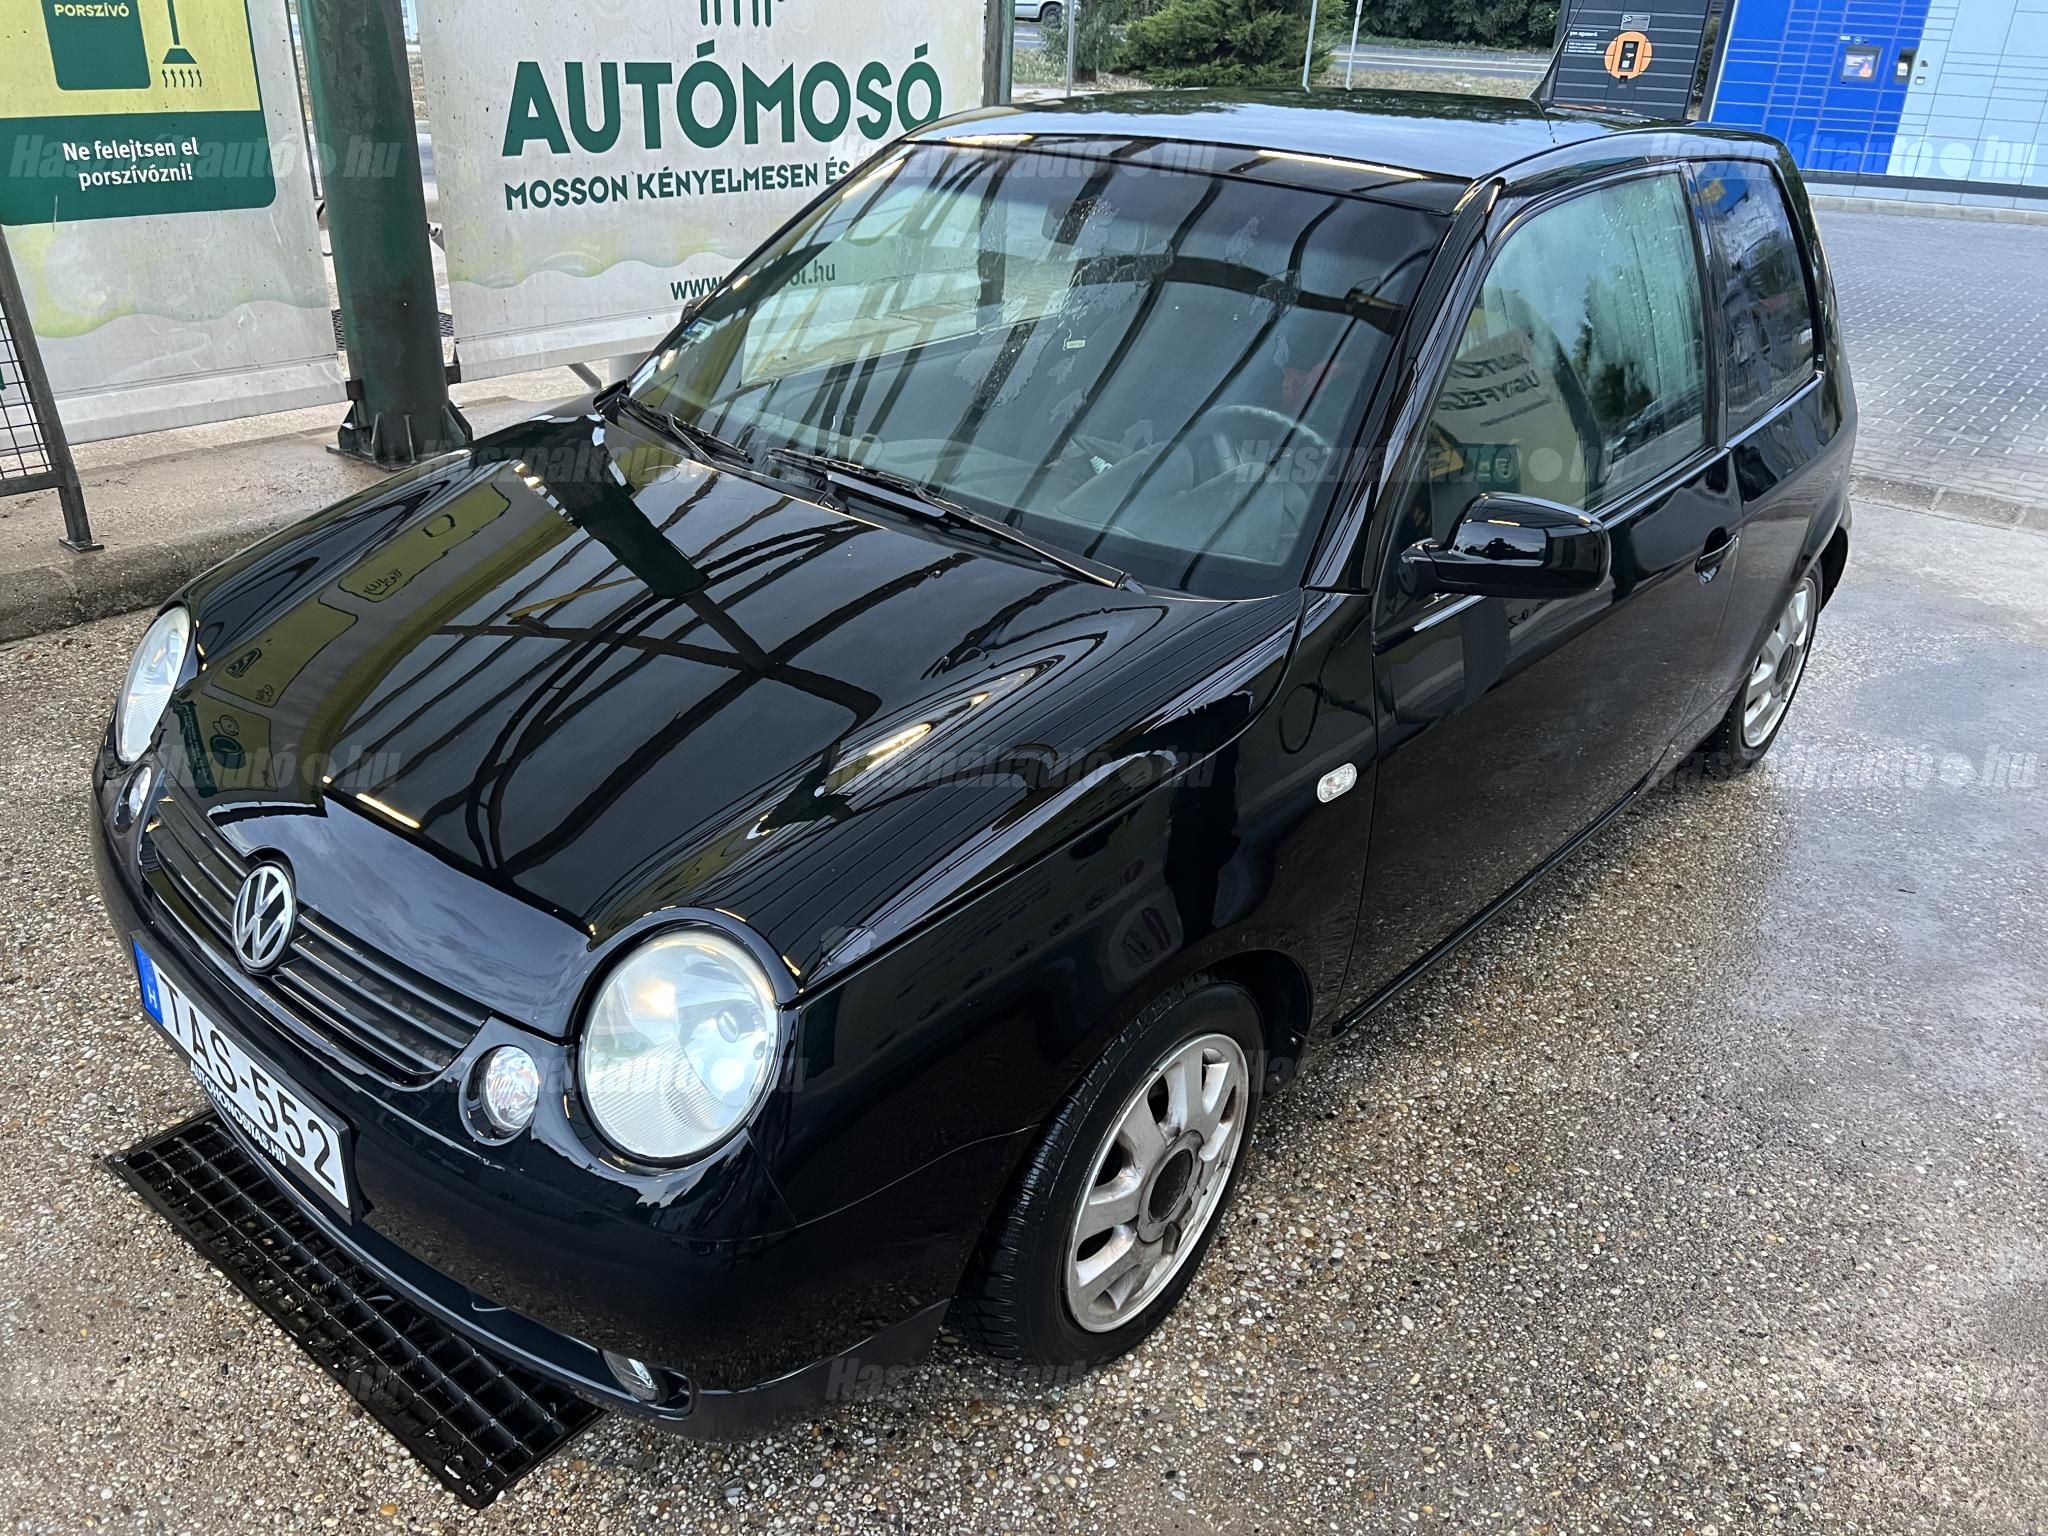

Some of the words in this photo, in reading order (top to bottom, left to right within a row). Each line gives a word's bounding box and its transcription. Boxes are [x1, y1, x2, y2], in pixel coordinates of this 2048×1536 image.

[54, 2, 130, 17] PORSZÍVÓ
[501, 39, 942, 156] AUTÓMOSÓ
[62, 142, 91, 161] Ne
[94, 138, 176, 162] felejtsen
[181, 136, 200, 156] el
[79, 163, 193, 191] porszívózni!
[504, 174, 628, 210] MOSSON
[637, 162, 818, 201] KÉNYELMESEN
[147, 985, 158, 1009] H
[158, 973, 336, 1190] TAS-552
